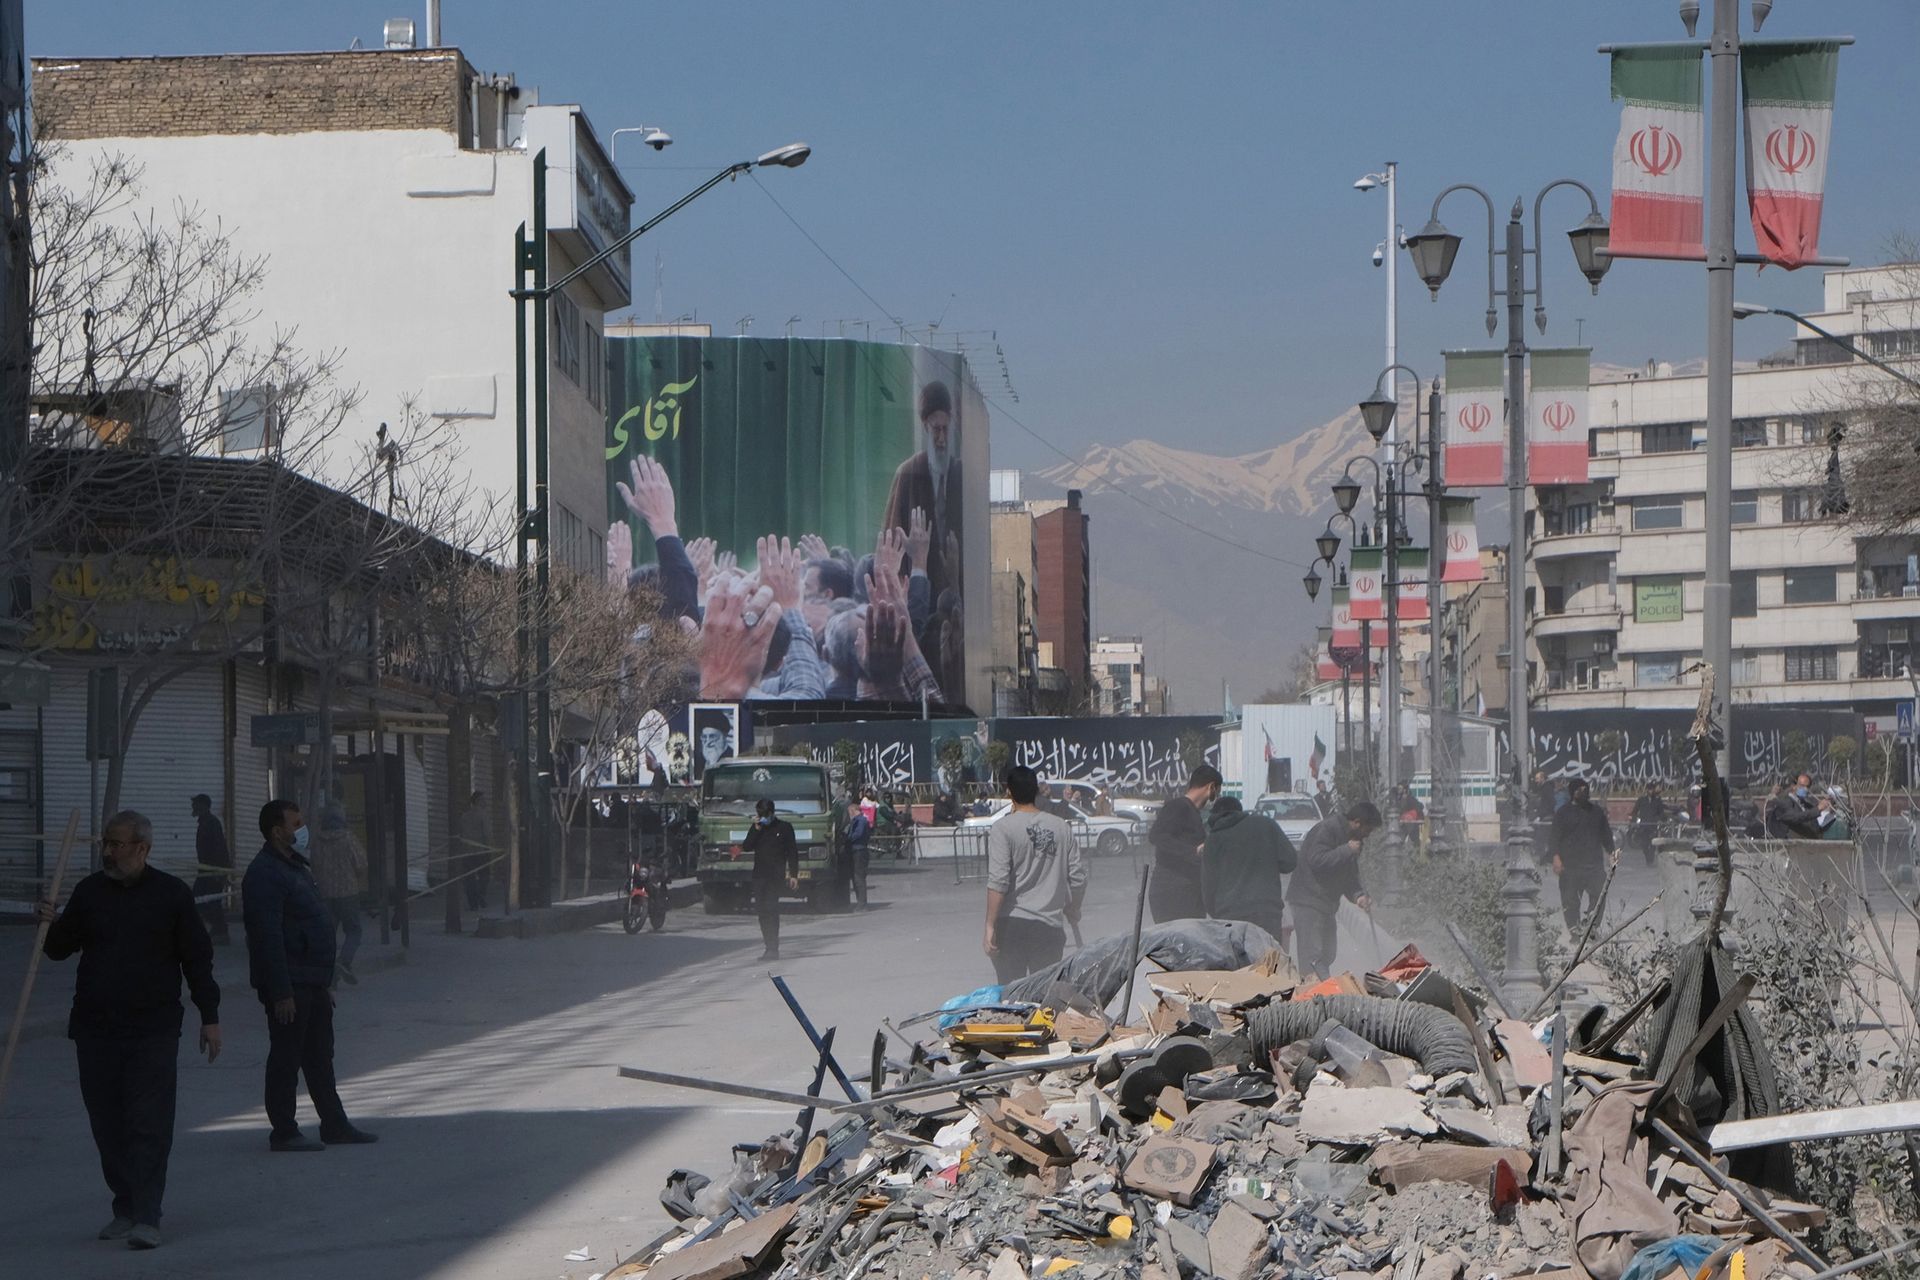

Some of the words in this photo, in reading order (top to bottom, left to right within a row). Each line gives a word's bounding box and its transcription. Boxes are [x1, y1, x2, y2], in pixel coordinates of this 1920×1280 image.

[606, 375, 698, 460] آقای
[1642, 588, 1678, 600] پلیس
[1640, 605, 1679, 616] POLICE
